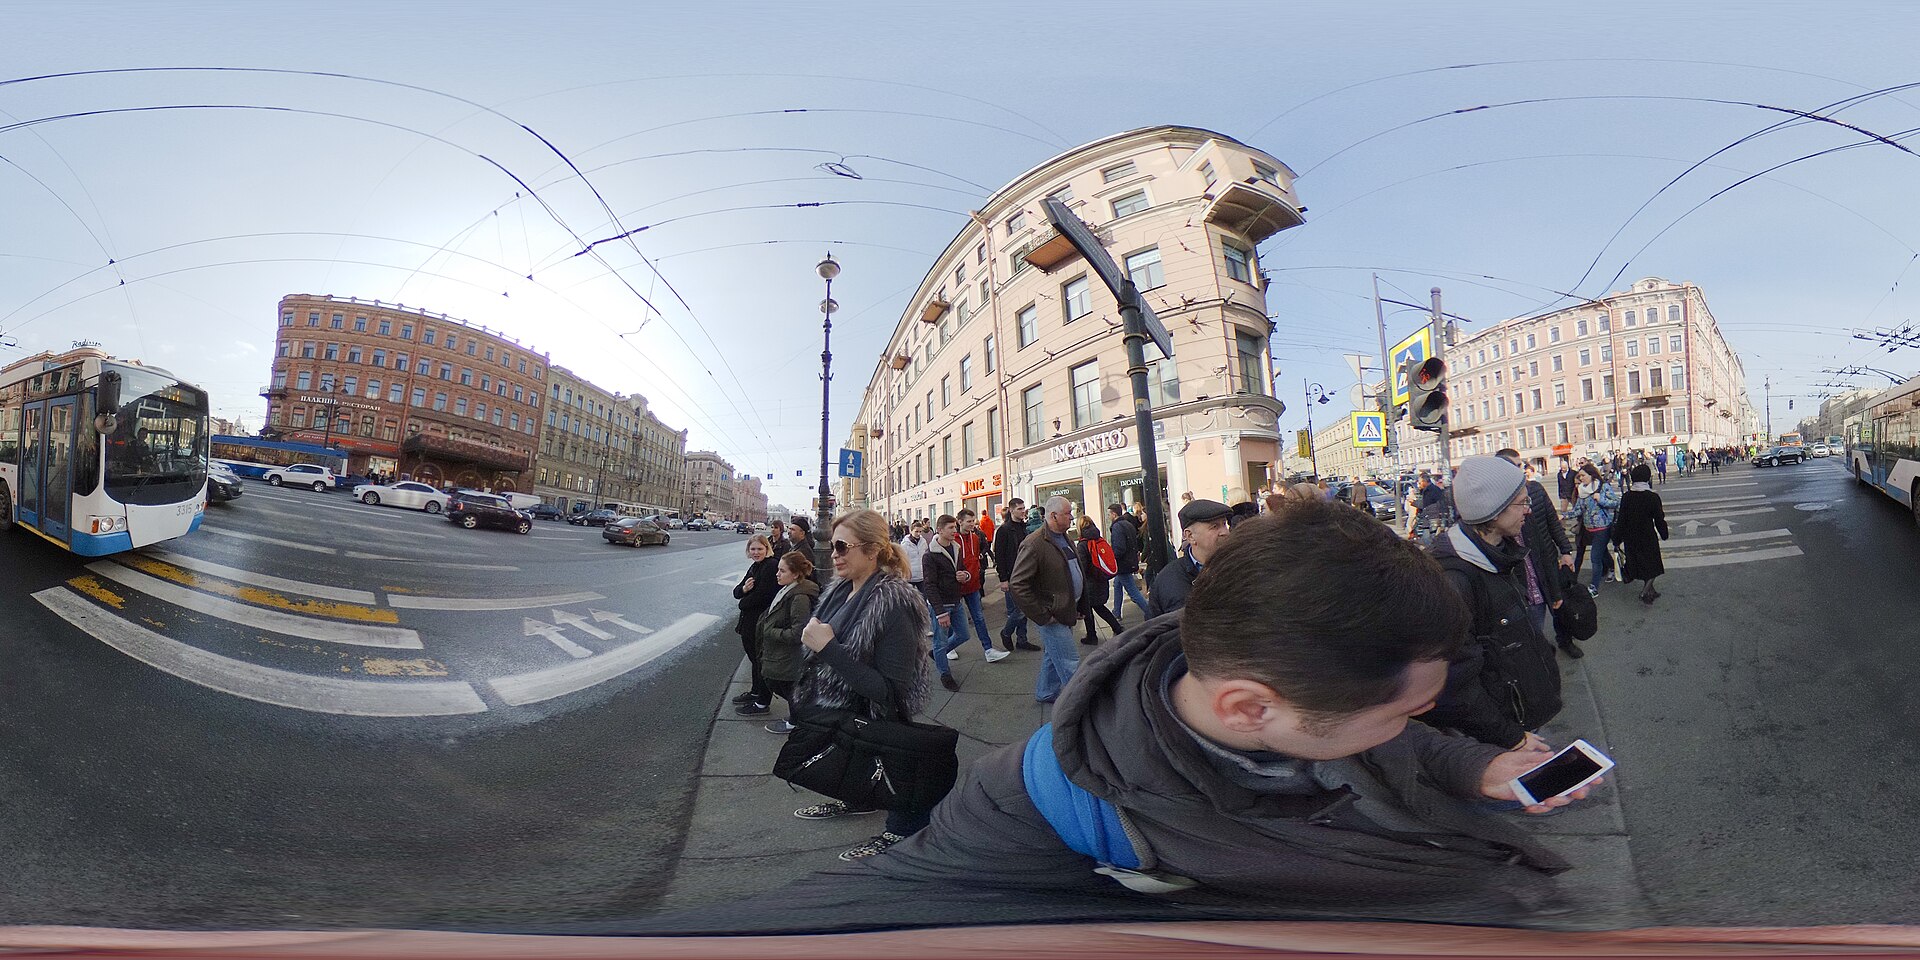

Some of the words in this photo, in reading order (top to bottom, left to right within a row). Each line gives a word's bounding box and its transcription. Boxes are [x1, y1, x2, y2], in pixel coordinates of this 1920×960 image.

[1050, 428, 1123, 462] INCANTO
[1120, 478, 1144, 487] INCANT
[1050, 488, 1069, 497] INCANTO
